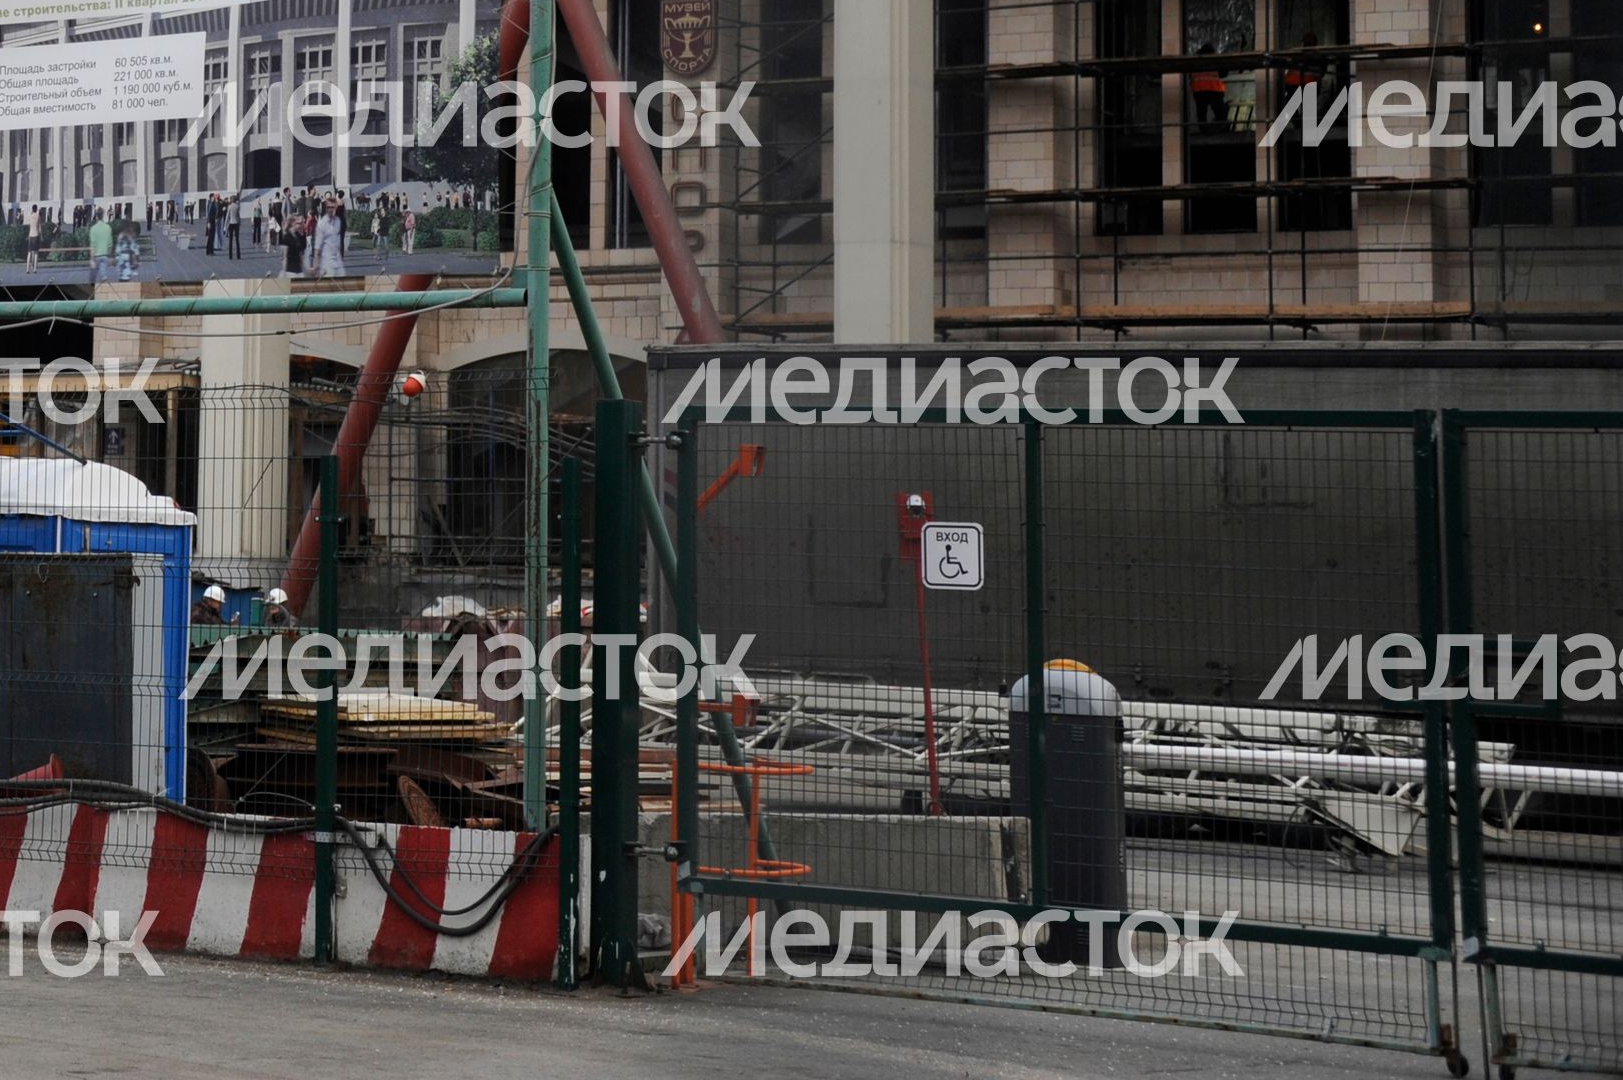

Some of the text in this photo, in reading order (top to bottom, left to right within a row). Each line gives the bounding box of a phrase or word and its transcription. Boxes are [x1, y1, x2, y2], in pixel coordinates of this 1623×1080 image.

[14, 0, 111, 19] строительства:
[0, 64, 45, 76] Площадь
[48, 59, 96, 73] застройки
[114, 57, 127, 68] 60
[129, 56, 147, 67] 505
[664, 48, 712, 71] СПОРТА
[35, 75, 79, 87] площадь
[114, 71, 131, 82] 221
[134, 70, 152, 80] 000
[71, 87, 102, 98] объем
[122, 85, 139, 95] 190
[142, 83, 160, 93] 000
[34, 101, 96, 114] вместимость
[112, 99, 124, 110] 81
[126, 98, 144, 109] 000
[147, 97, 168, 107] чел.
[936, 532, 968, 544] ВХОД
